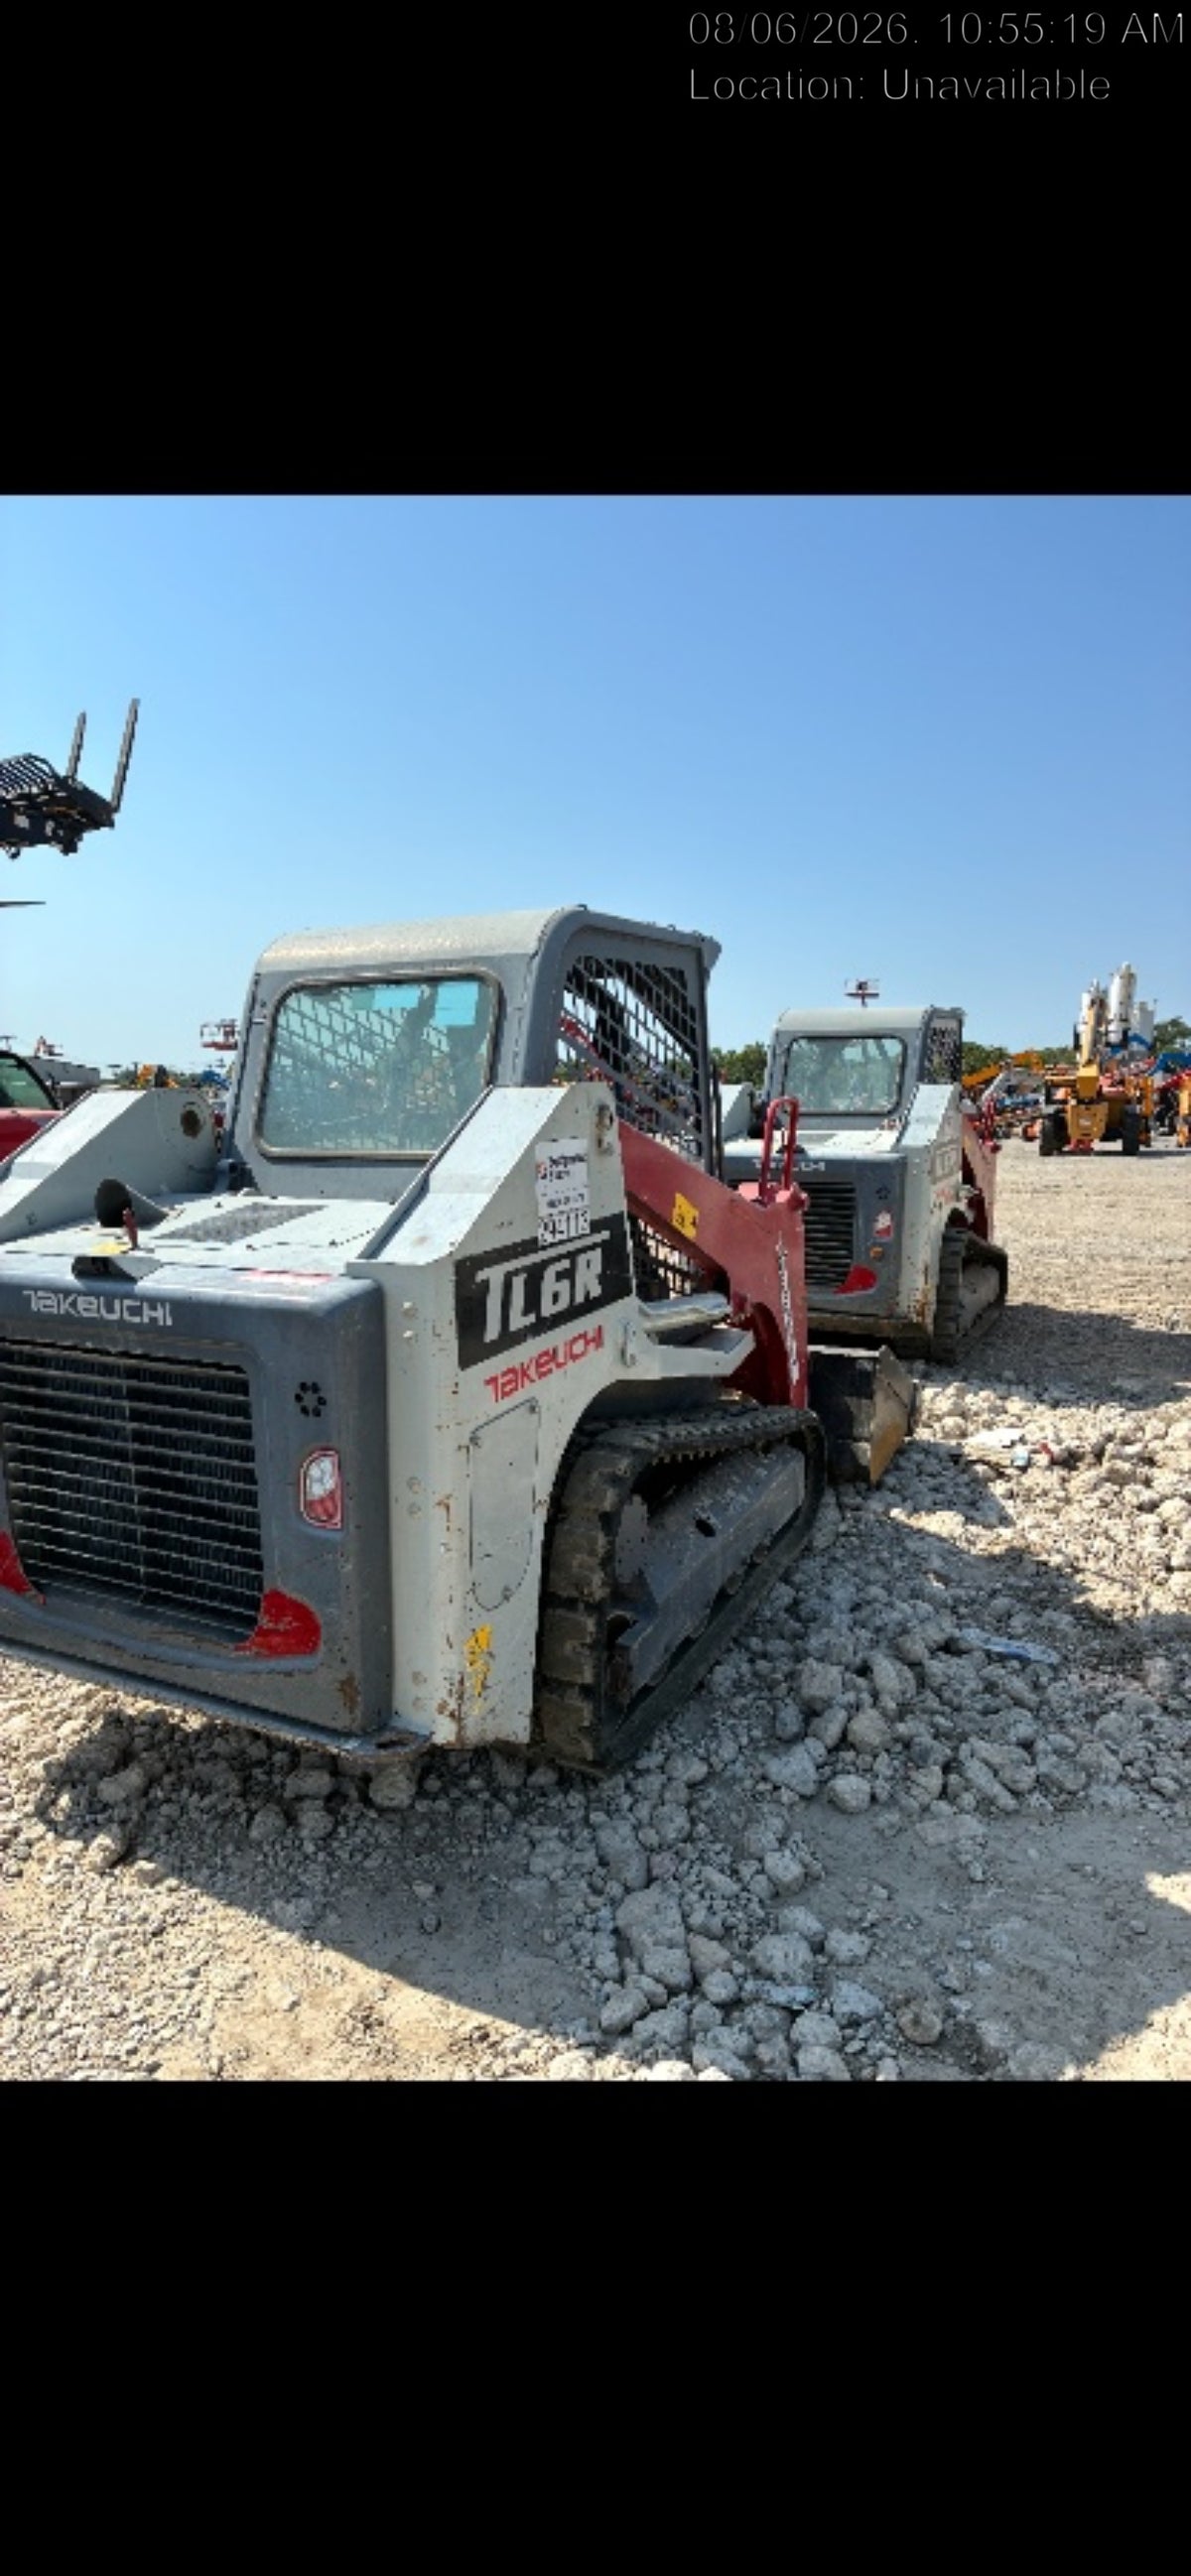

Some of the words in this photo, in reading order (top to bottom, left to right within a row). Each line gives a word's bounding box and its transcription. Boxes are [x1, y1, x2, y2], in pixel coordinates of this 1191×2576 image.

[22, 1290, 173, 1326] TAKEUCHI
[475, 1229, 611, 1343] TL6R
[484, 1324, 603, 1402] TAKEUCHI
